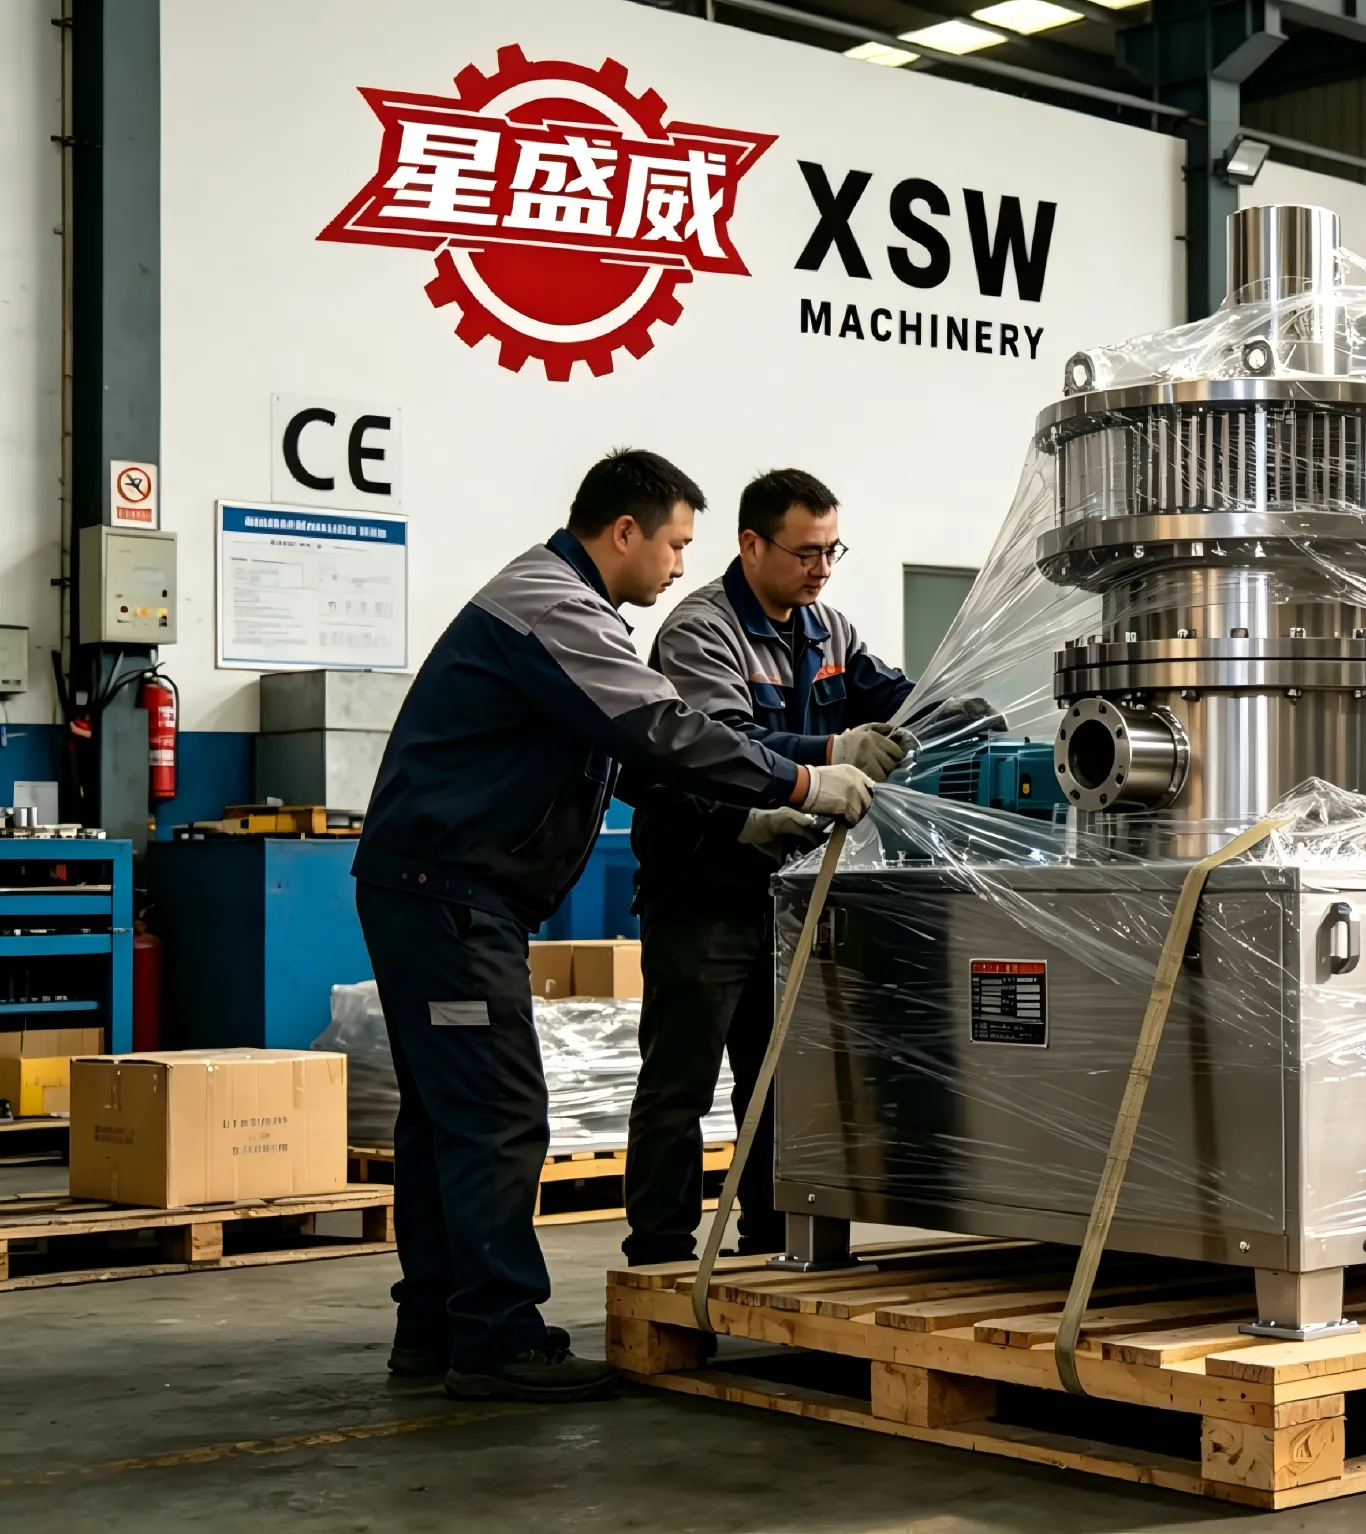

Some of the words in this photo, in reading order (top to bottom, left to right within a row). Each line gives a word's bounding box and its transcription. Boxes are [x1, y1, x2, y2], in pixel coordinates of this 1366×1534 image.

[378, 119, 729, 259] 星盛威
[794, 160, 1058, 303] XSW
[800, 298, 1045, 361] MACHINERY
[282, 407, 392, 495] CE
